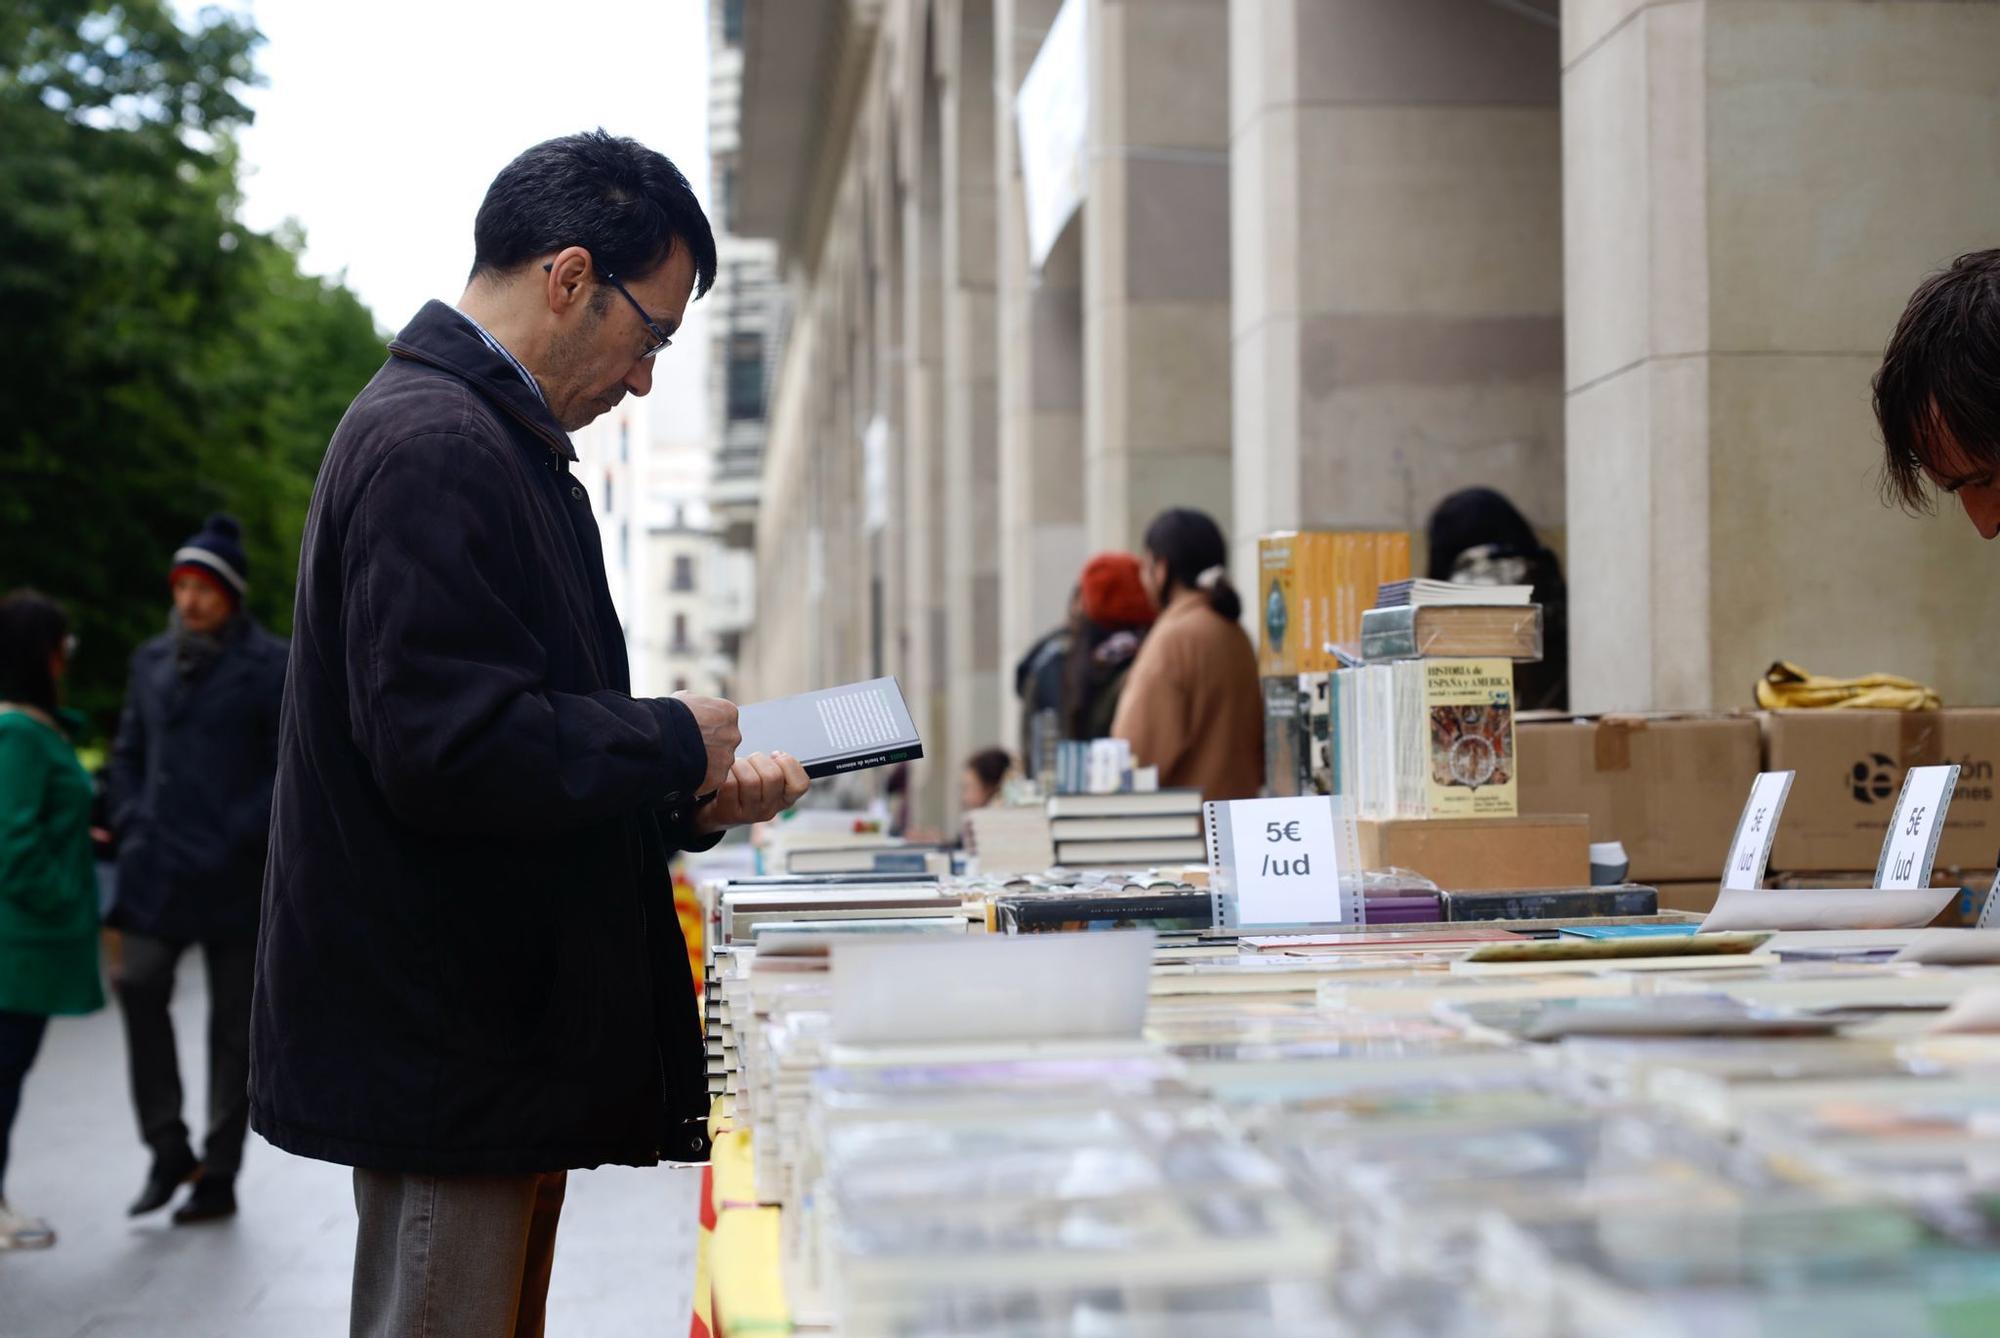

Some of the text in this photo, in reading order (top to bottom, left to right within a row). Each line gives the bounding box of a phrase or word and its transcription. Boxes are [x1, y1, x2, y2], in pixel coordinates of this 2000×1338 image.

[1428, 665, 1482, 676] HISTORIA de
[1266, 820, 1302, 843] 5€
[1750, 807, 1767, 832] 5€
[1906, 806, 1925, 836] 5€
[1261, 853, 1311, 877] /ud
[1891, 850, 1915, 881] /ud
